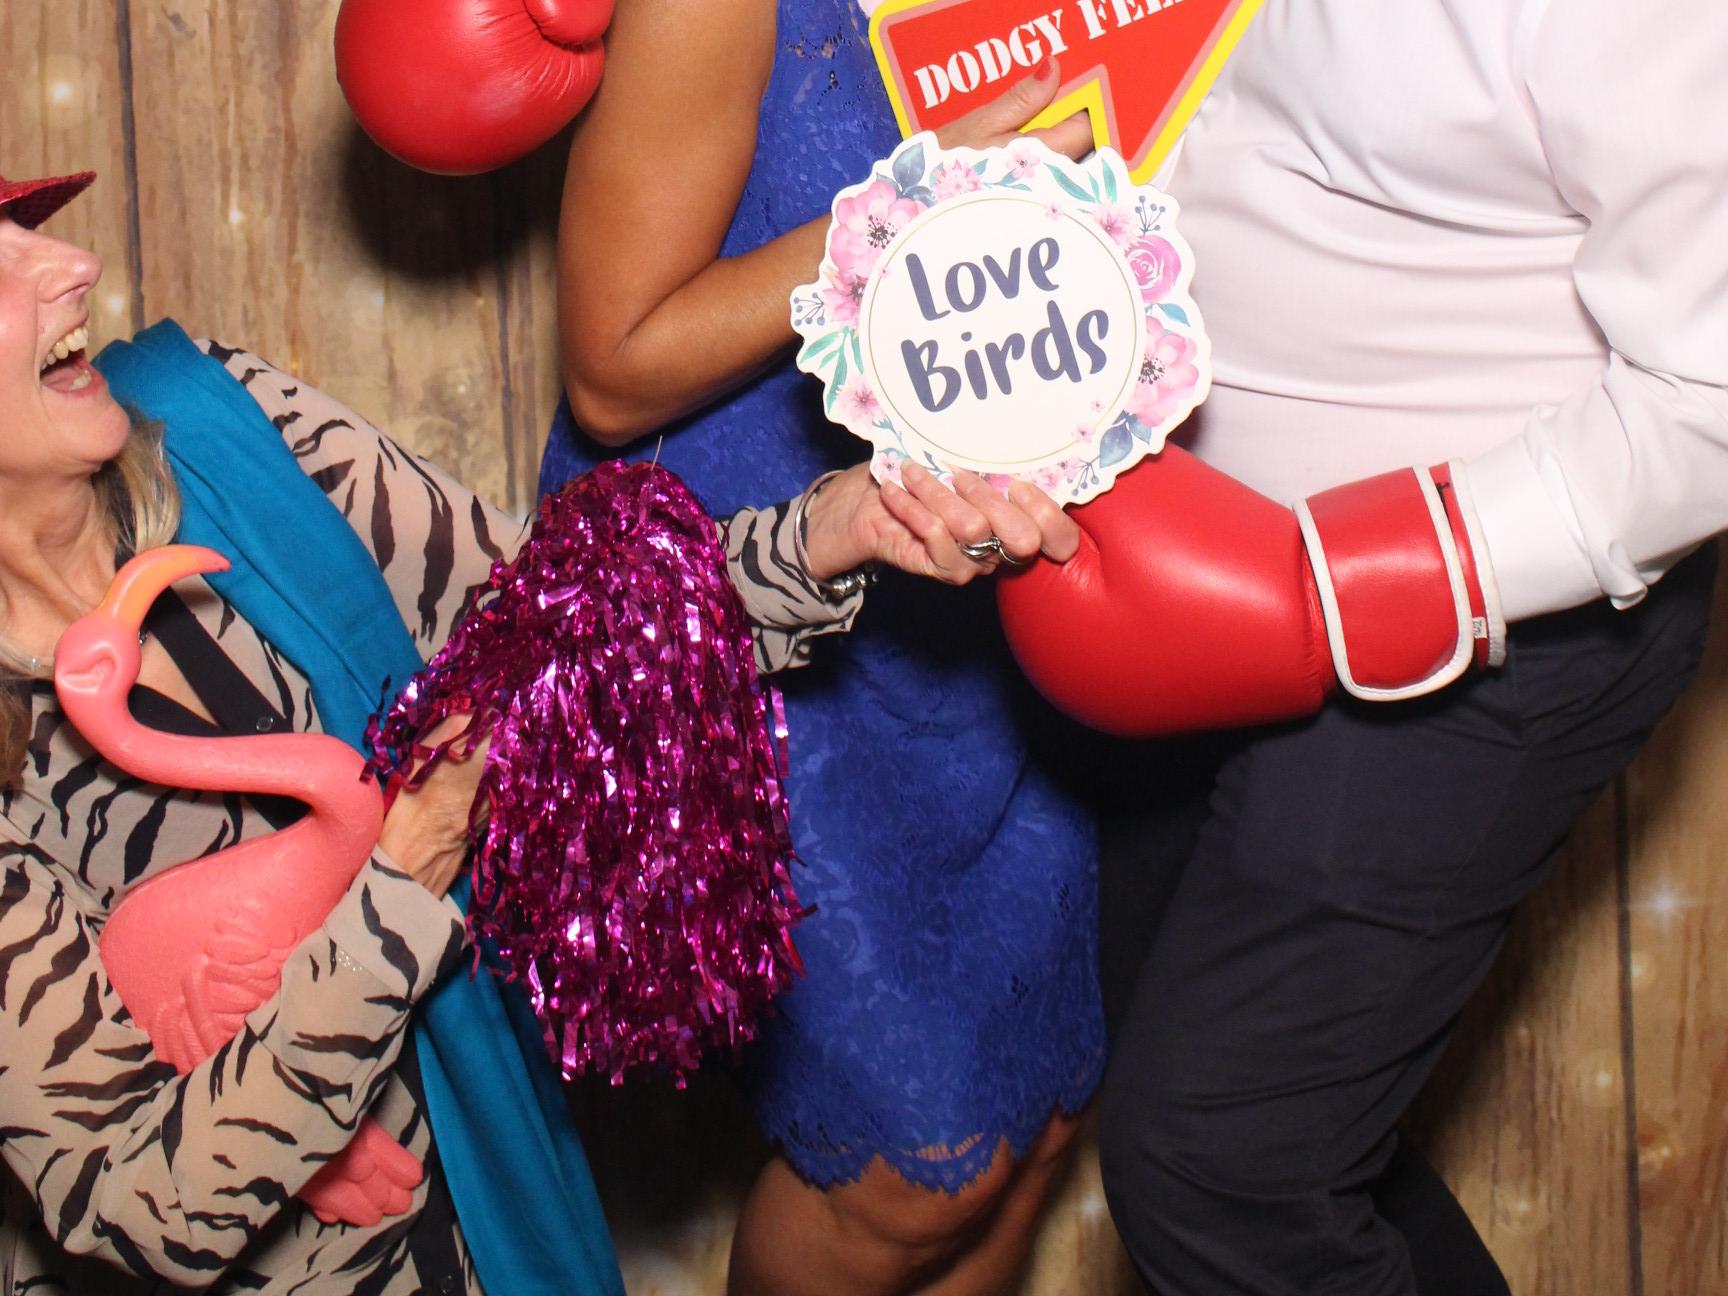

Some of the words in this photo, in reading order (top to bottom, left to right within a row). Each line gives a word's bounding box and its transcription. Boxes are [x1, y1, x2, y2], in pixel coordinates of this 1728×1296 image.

[913, 7, 1068, 109] DODGY
[905, 237, 1060, 321] Love
[900, 300, 1110, 413] Birds
